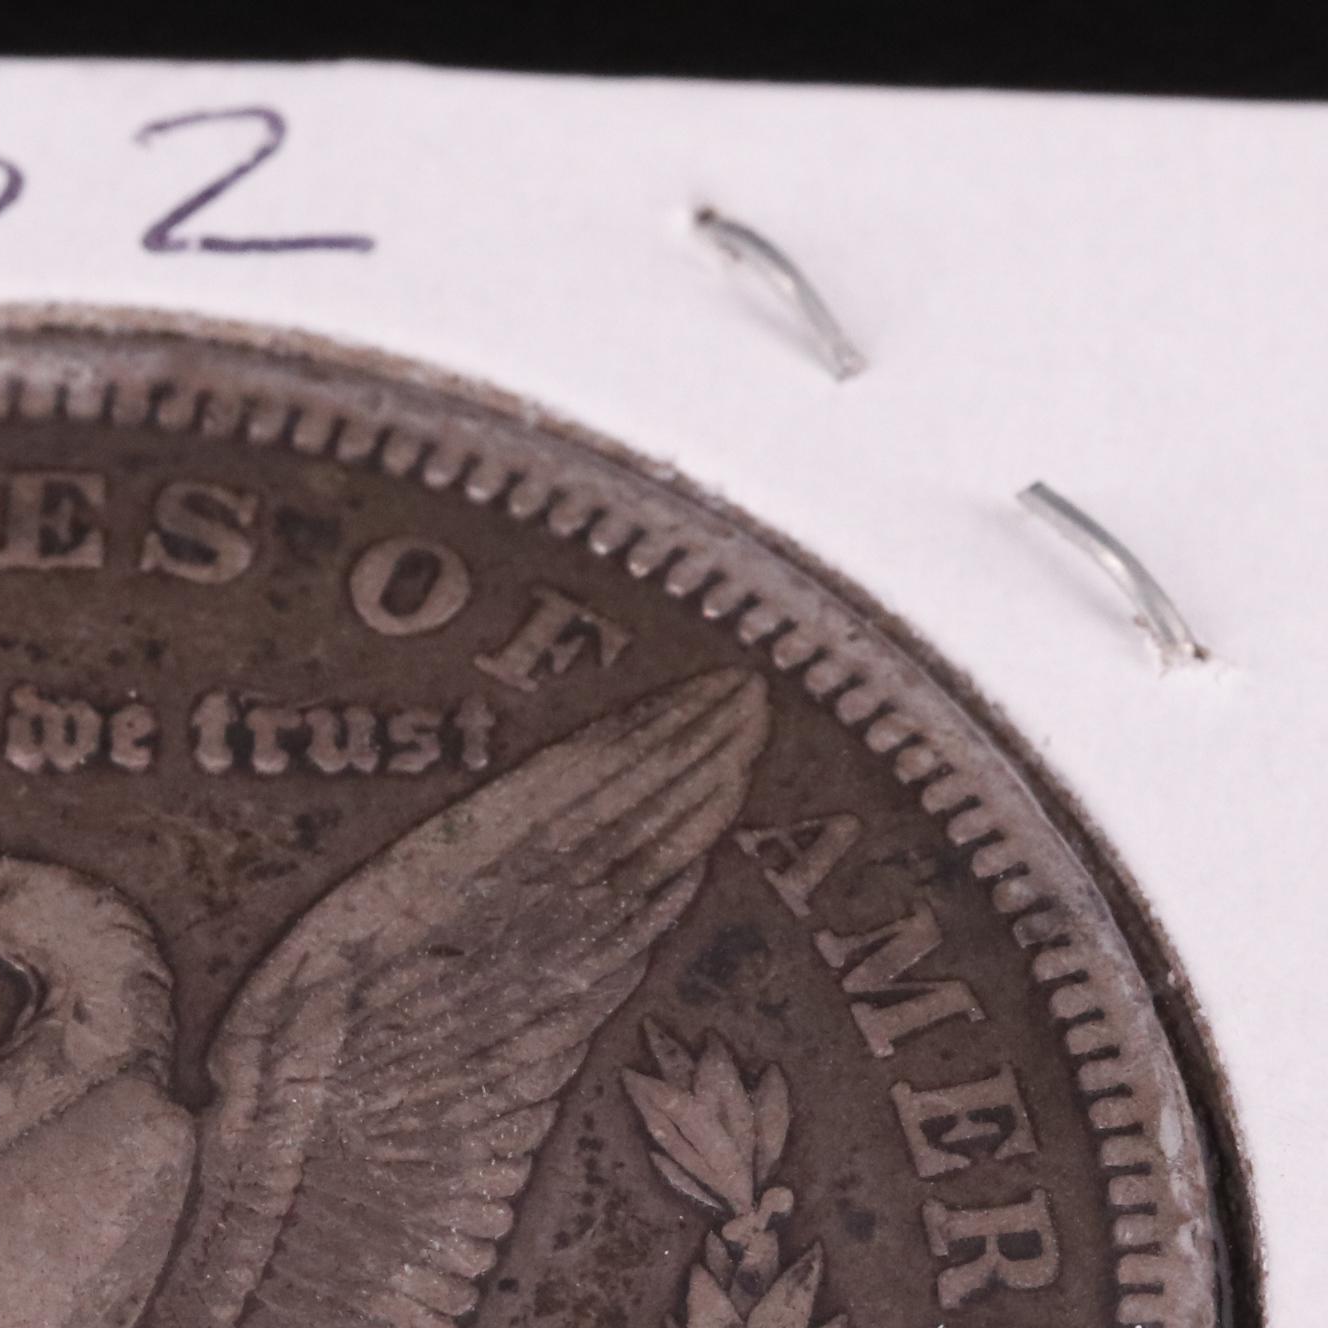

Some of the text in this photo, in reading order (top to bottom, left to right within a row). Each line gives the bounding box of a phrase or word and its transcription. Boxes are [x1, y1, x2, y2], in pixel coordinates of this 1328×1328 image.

[348, 536, 634, 693] OF
[5, 685, 155, 773] we
[191, 690, 496, 774] trust
